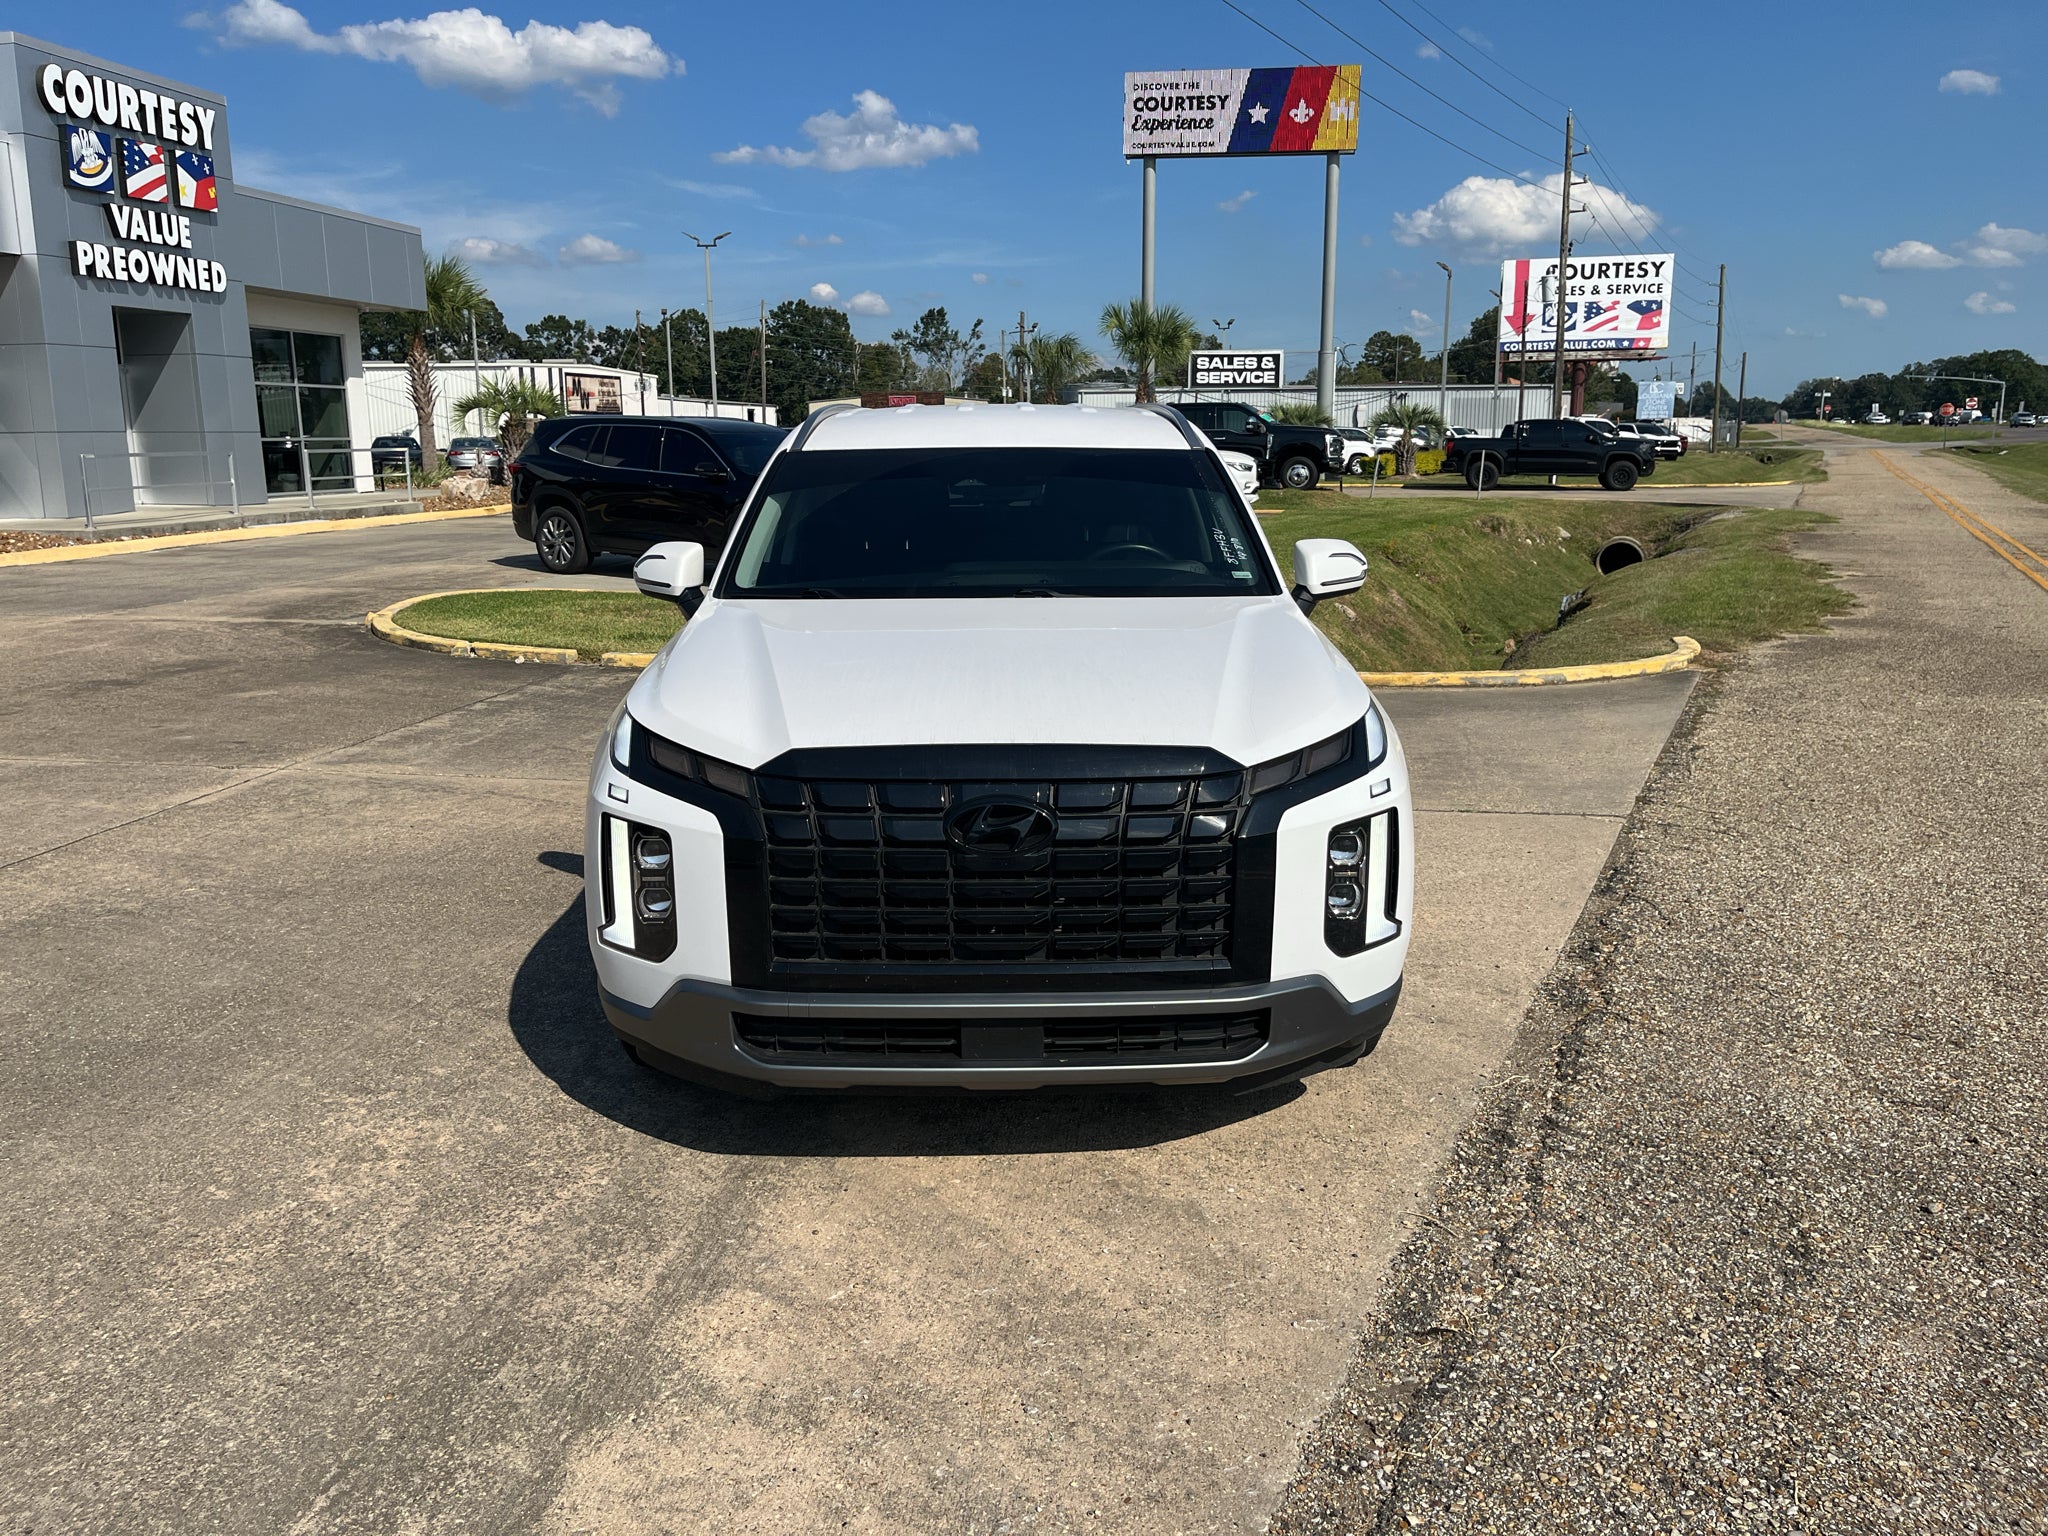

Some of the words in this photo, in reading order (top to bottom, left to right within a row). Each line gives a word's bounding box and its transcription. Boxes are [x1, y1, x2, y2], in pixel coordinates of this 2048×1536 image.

[1133, 82, 1180, 91] DISCOVER
[1183, 81, 1200, 90] THE
[40, 63, 215, 150] COURTESY
[1133, 95, 1230, 112] COURTESY
[1132, 115, 1215, 135] Experience
[109, 202, 192, 249] VALUE
[75, 240, 227, 293] PREOWNED
[1591, 284, 1600, 296] &
[1607, 283, 1664, 295] SERVICE
[1504, 340, 1616, 351] CORTESYALUE.COM
[1197, 357, 1257, 369] SALES
[1261, 357, 1275, 369] &
[1196, 371, 1275, 384] SERVICE
